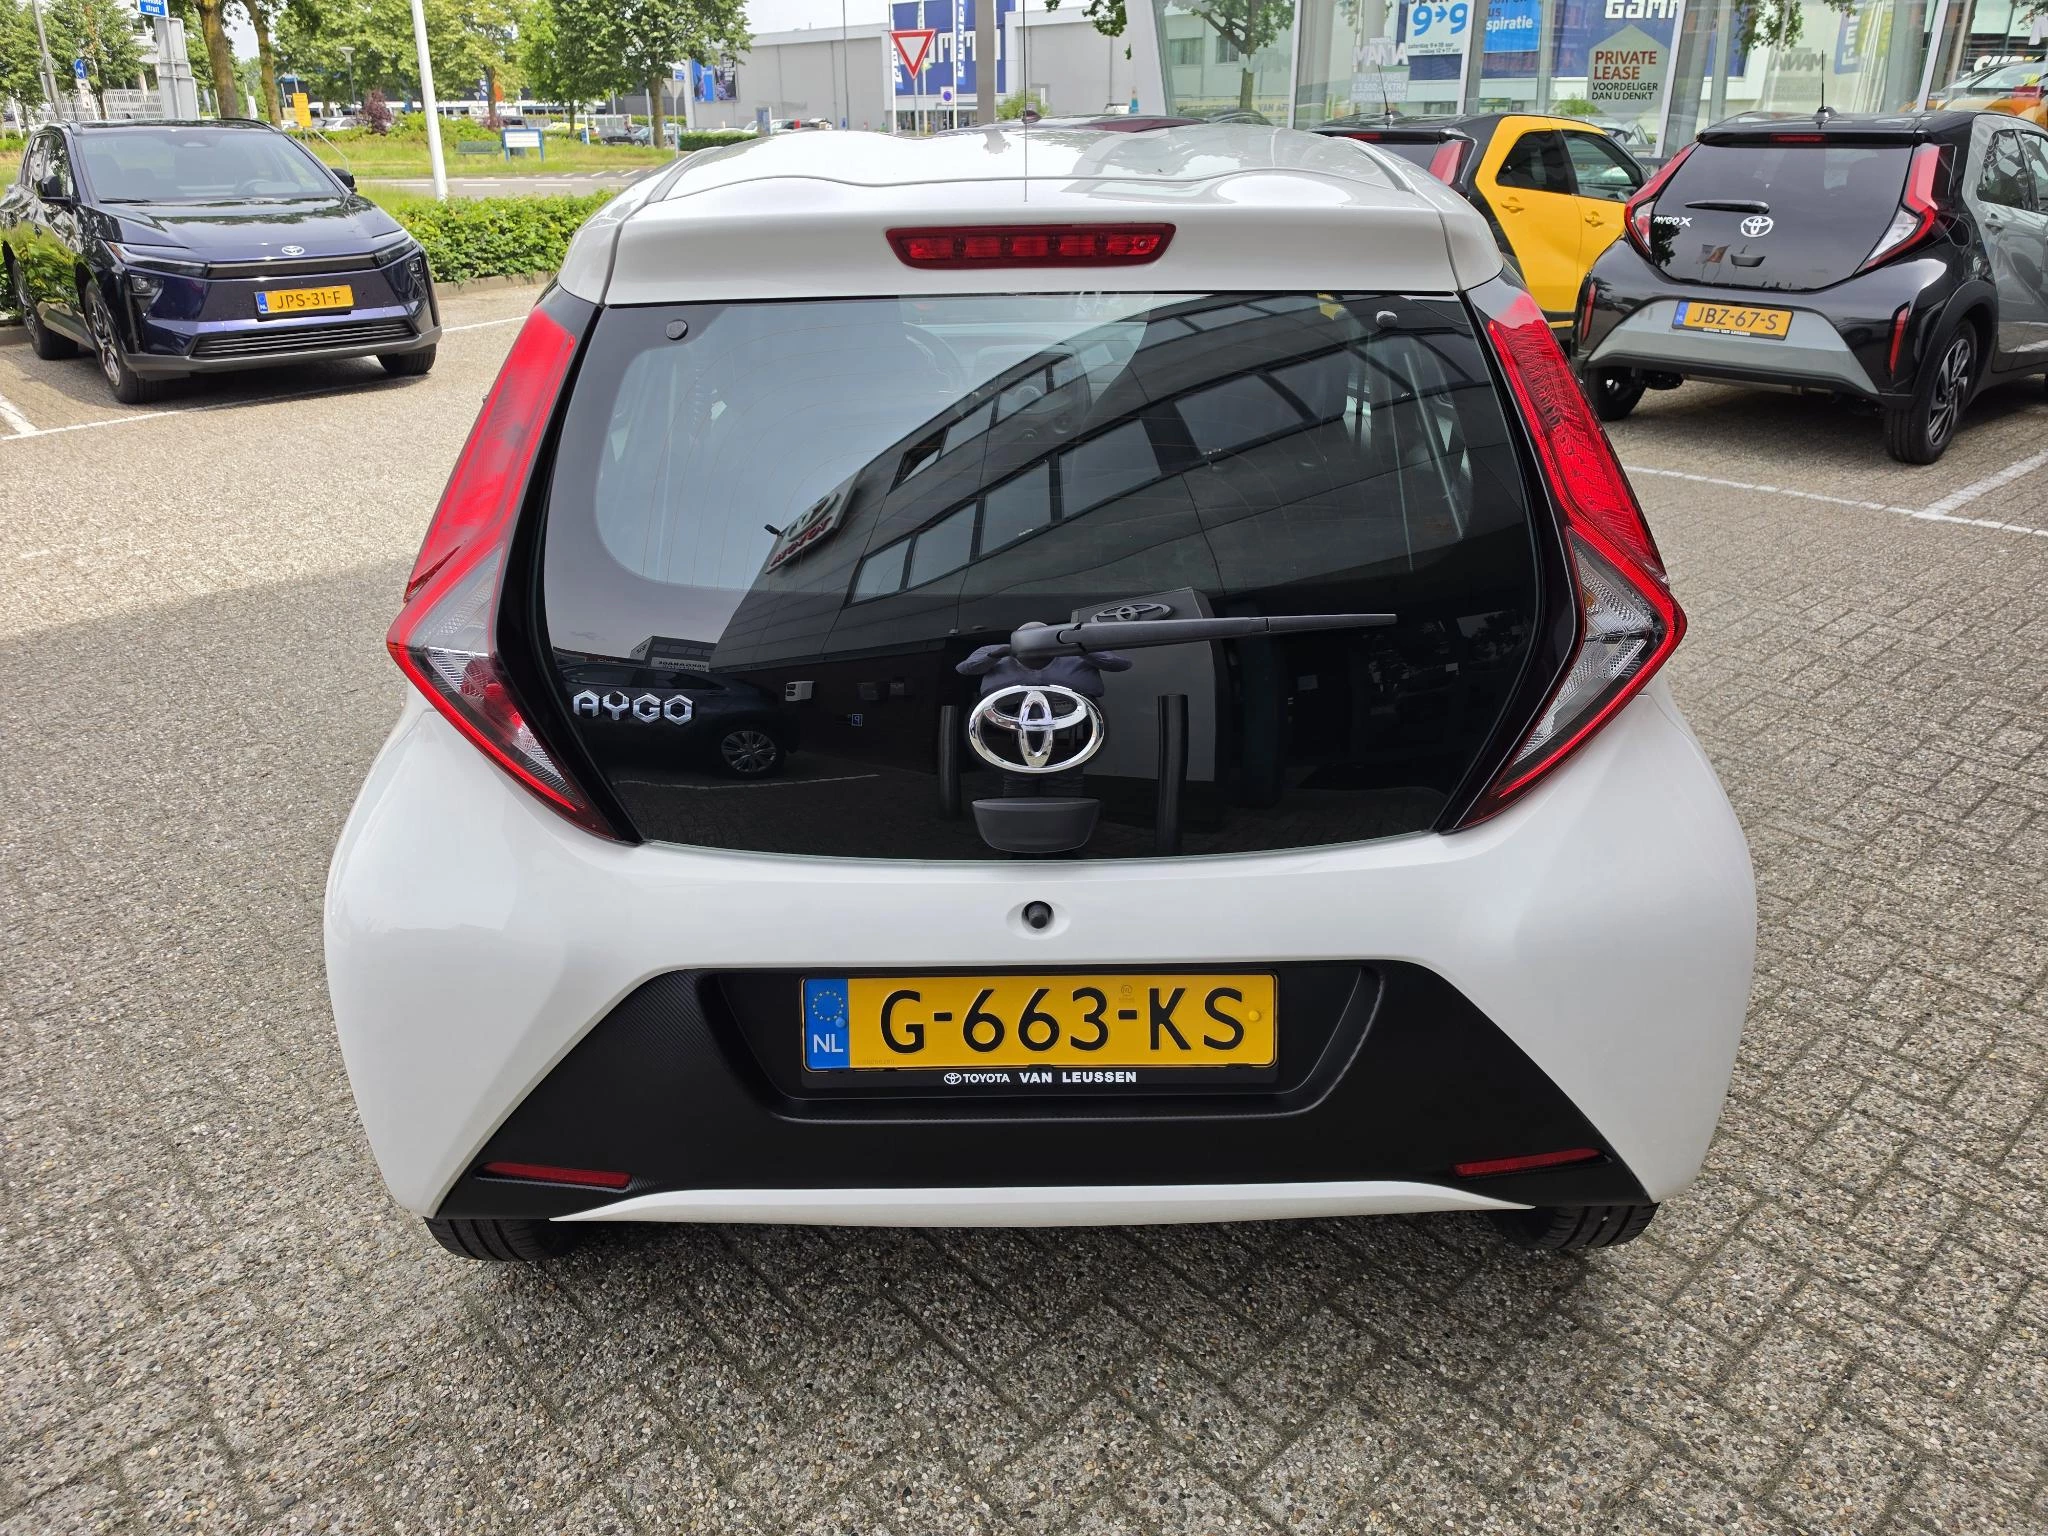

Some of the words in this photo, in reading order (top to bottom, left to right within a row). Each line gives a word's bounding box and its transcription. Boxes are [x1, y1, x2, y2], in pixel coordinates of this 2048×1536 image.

[1412, 5, 1433, 36] 9
[1450, 3, 1468, 34] 9
[1486, 15, 1533, 33] spiratie
[1595, 51, 1657, 65] PRIVATE
[1593, 66, 1641, 80] LEASE
[1592, 82, 1658, 91] VOORDELIGER
[1592, 91, 1611, 100] DAN
[1614, 91, 1621, 100] U
[1622, 91, 1654, 100] DENKT
[1679, 217, 1693, 227] X
[277, 290, 341, 309] JPS-31-F
[1694, 307, 1779, 331] JBZ-67-S
[573, 689, 694, 726] AYGO
[879, 986, 1246, 1054] G-663-KS
[813, 1033, 844, 1053] NL
[962, 1073, 1011, 1084] TOYOTA
[1019, 1071, 1053, 1084] VAN
[1062, 1071, 1137, 1084] LEUSSEN
